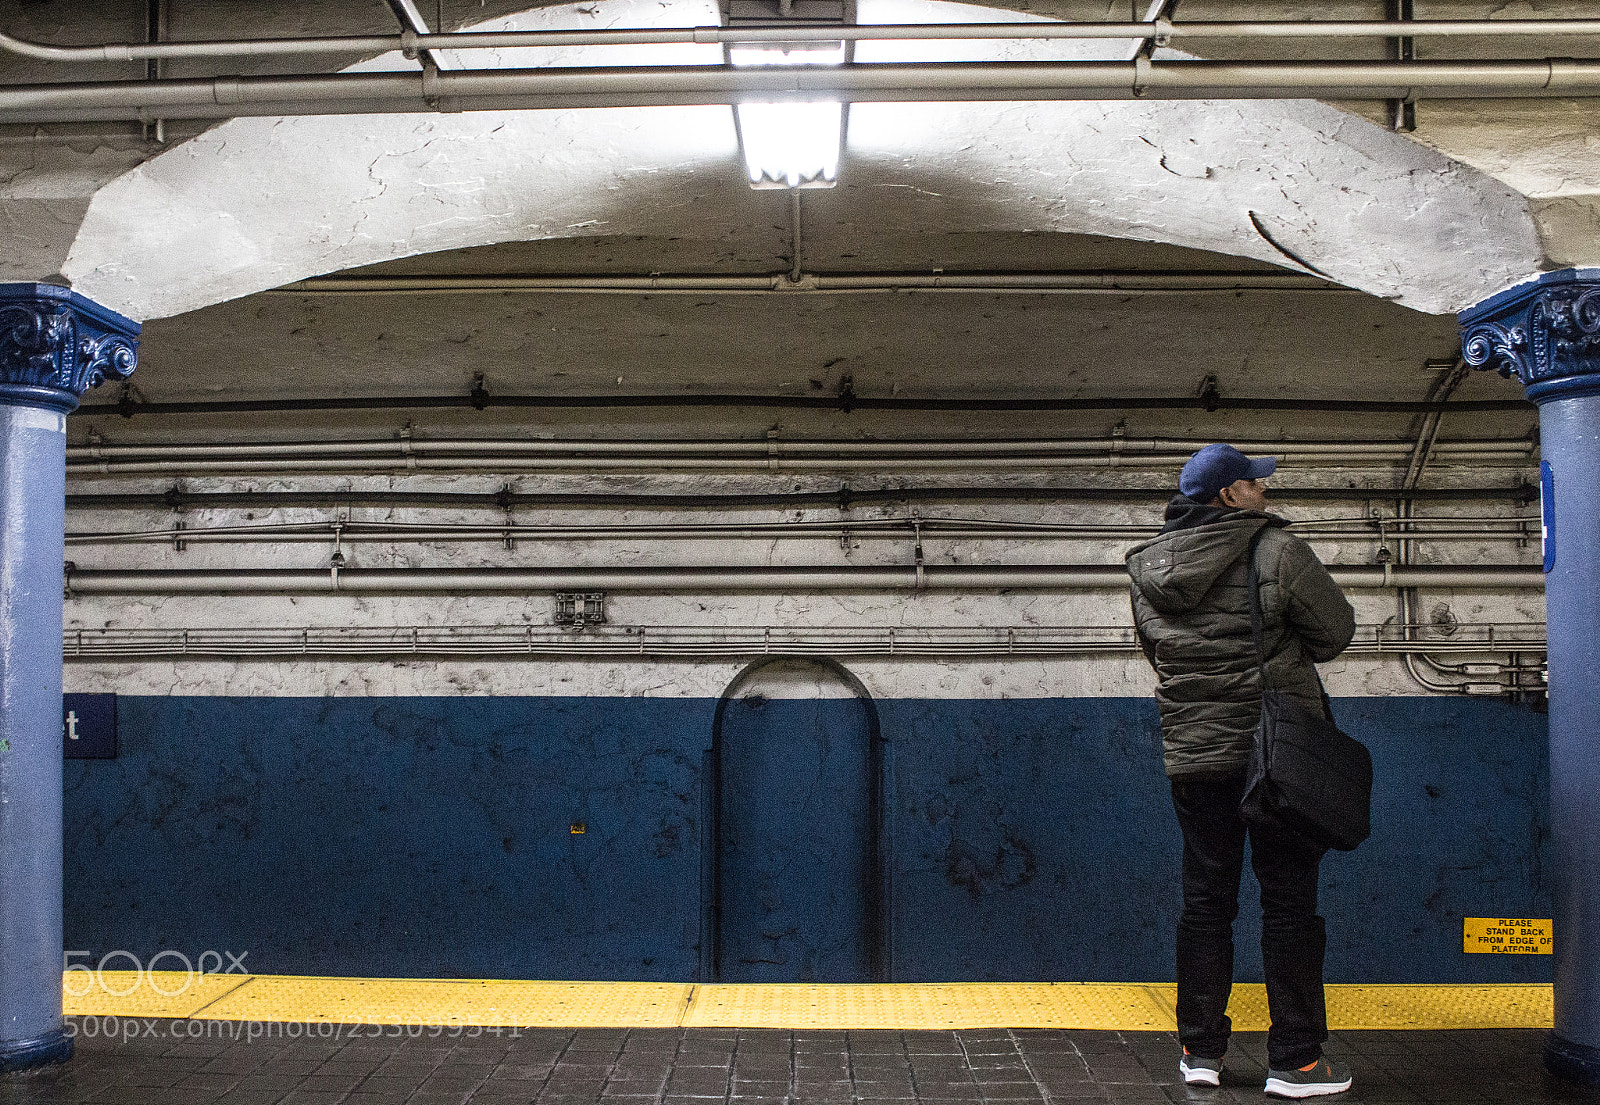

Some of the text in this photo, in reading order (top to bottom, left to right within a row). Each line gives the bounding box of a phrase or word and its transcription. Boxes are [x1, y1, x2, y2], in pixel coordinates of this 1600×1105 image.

[63, 710, 79, 740] t
[1498, 919, 1532, 927] PLEASE
[1486, 927, 1545, 936] STAND BACK
[1478, 936, 1552, 945] FROM EDGE OF
[1491, 945, 1539, 953] PLATFORM
